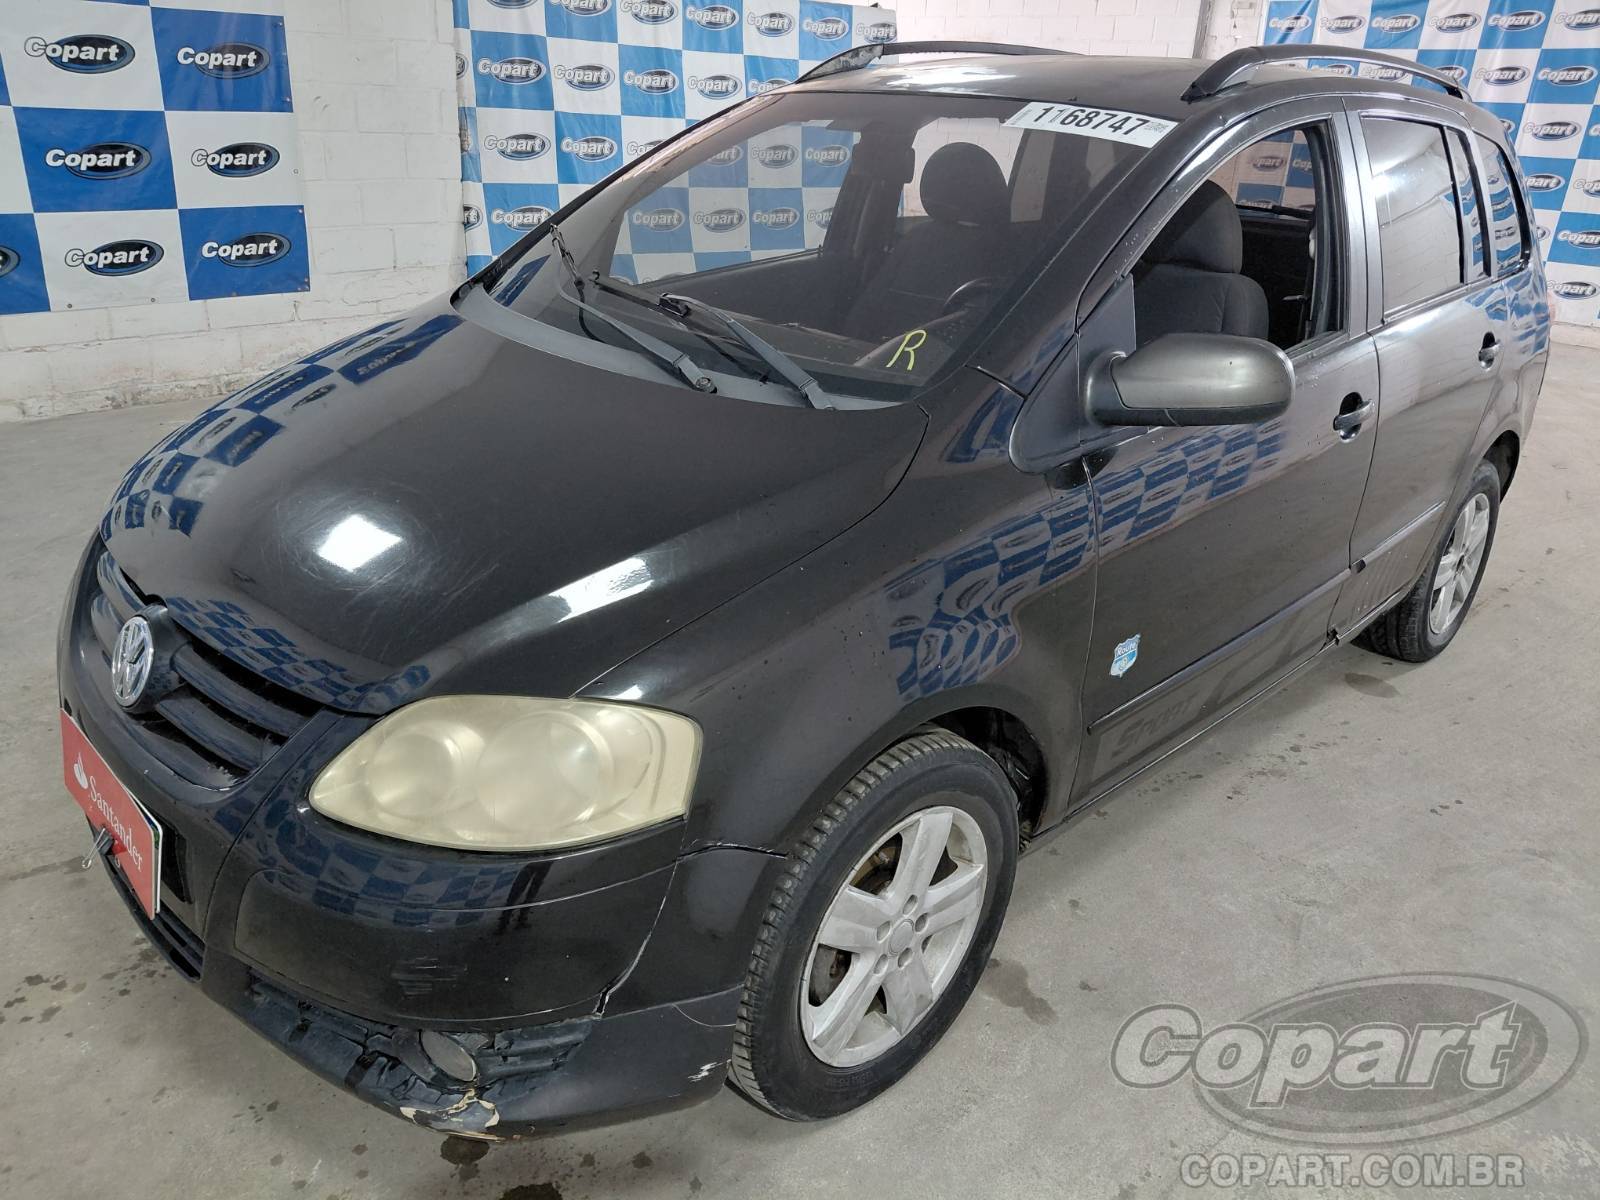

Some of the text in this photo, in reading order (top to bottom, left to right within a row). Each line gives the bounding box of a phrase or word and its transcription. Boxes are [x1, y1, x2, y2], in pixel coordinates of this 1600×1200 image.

[621, 0, 671, 17] Copart
[686, 7, 733, 25] Copart
[748, 12, 792, 31] Copart
[1269, 18, 1307, 30] Copart
[1320, 17, 1361, 29] Copart
[1371, 16, 1414, 29] Copart
[1430, 16, 1474, 29] Copart
[1488, 13, 1538, 28] Copart
[1555, 11, 1600, 26] Copar
[803, 19, 844, 35] Copart
[856, 23, 896, 39] Copart
[24, 36, 120, 62] Copart
[177, 46, 257, 70] Copart
[478, 57, 539, 77] Copart
[554, 64, 609, 83] Copart
[1475, 67, 1523, 82] Copart
[624, 70, 677, 88] Copart
[1538, 69, 1591, 82] Copart
[688, 75, 737, 94] Copart
[1034, 106, 1150, 136] 1168747
[1523, 122, 1576, 137] Copart
[484, 135, 545, 153] Copart
[561, 136, 612, 155] Copart
[45, 148, 137, 171] Copart
[191, 149, 267, 170] Copart
[750, 147, 792, 164] Copart
[805, 148, 844, 162] Copart
[1526, 176, 1559, 188] part
[1574, 179, 1600, 193] Cop
[491, 209, 549, 225] Copart
[632, 211, 680, 227] Copart
[694, 210, 740, 226] Copart
[753, 210, 795, 225] Copart
[1557, 230, 1600, 245] Copar
[201, 239, 278, 260] Copart
[65, 248, 150, 269] Copart
[1547, 280, 1594, 295] Copart
[886, 329, 926, 371] R
[89, 775, 142, 873] Santander
